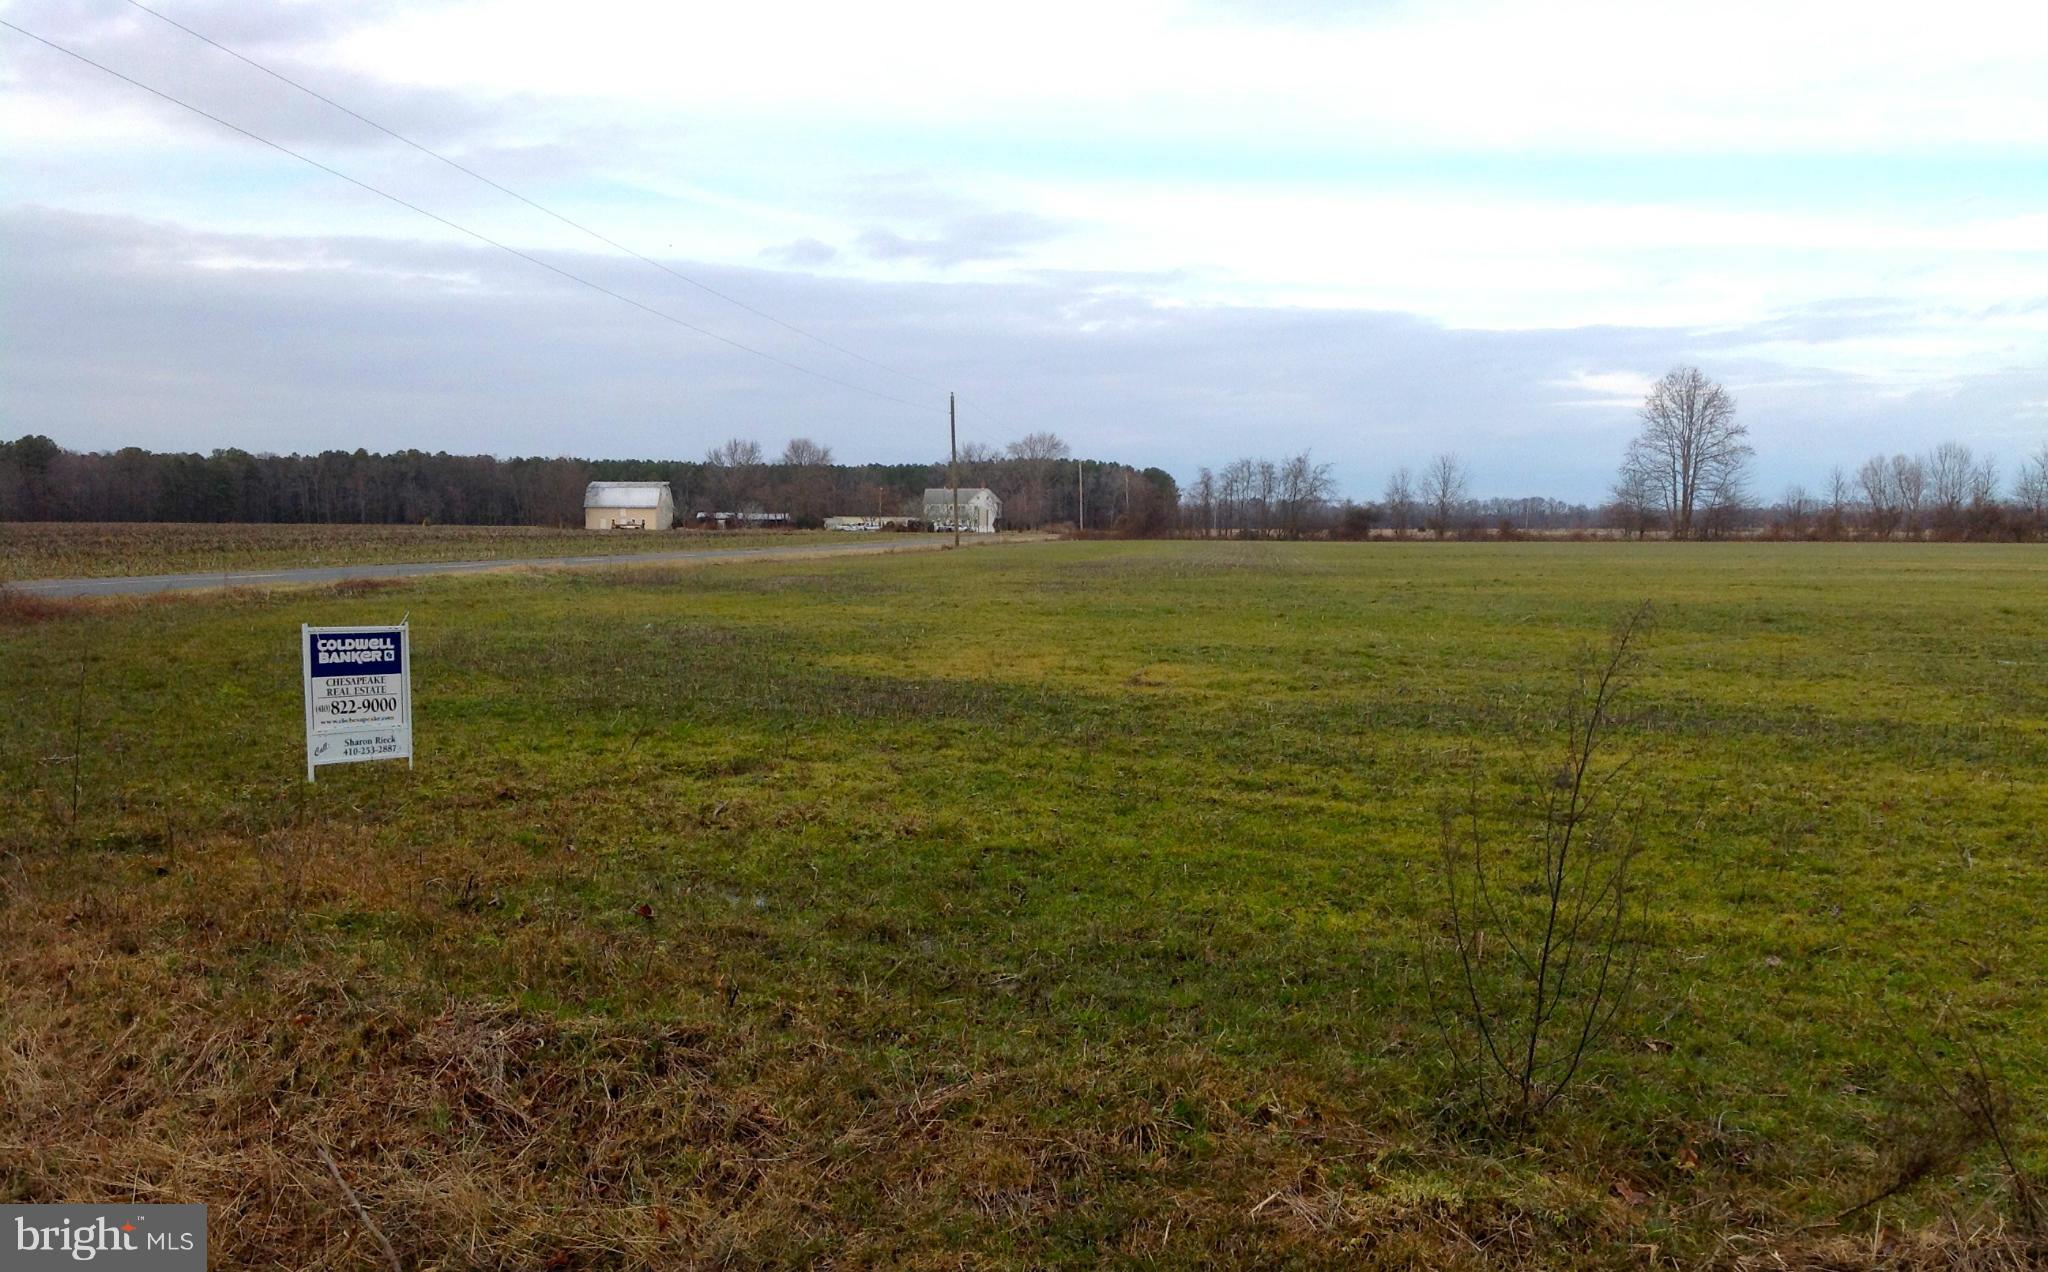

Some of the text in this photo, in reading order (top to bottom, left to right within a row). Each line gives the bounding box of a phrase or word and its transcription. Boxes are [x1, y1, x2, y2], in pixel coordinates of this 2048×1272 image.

[317, 638, 395, 651] COLDWELL
[318, 650, 382, 664] BANKER
[326, 676, 387, 686] CHESAPEAKE
[326, 686, 387, 696] REAL ESTATE
[331, 697, 397, 715] 822-9000
[344, 738, 372, 747] Sharon
[343, 745, 397, 756] 410-253-2887
